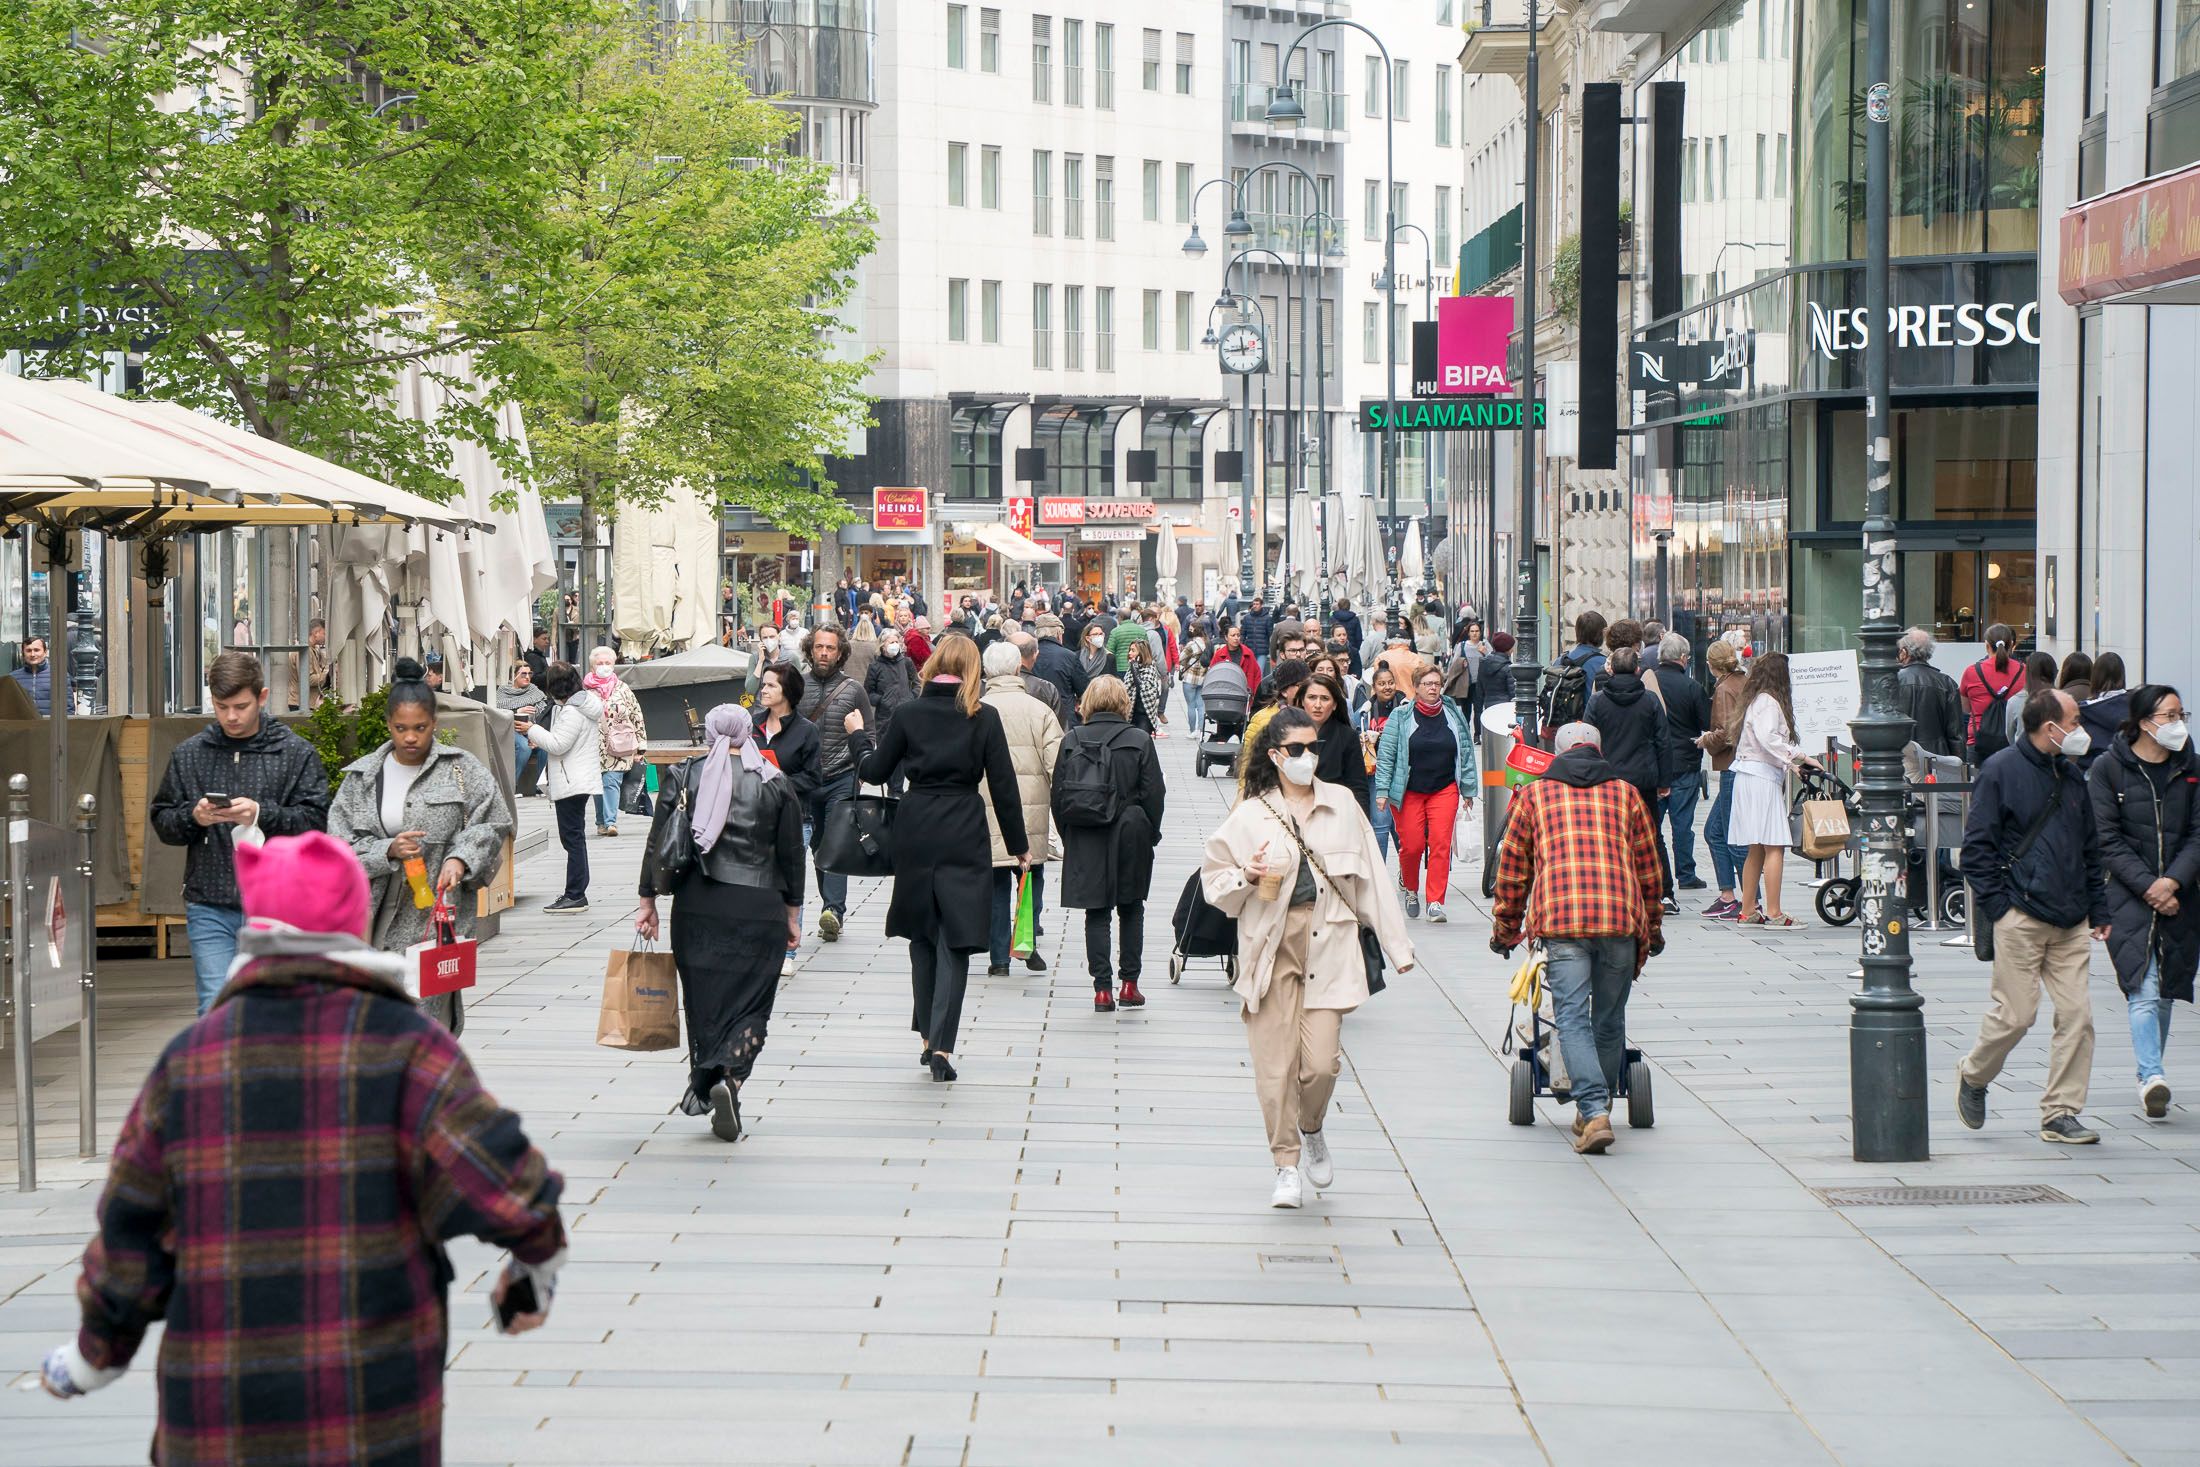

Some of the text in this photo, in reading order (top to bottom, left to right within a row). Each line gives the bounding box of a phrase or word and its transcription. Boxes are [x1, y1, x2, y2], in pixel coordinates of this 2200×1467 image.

[1445, 365, 1505, 386] BIPA
[1369, 403, 1545, 428] SALAMANDER
[879, 503, 922, 513] HEINDL
[1045, 502, 1083, 519] SOUVENIRS
[1088, 502, 1155, 519] SOUVENIRS
[1092, 530, 1136, 539] SOUVENIRS
[1808, 664, 1842, 673] Gesundheit
[437, 958, 460, 977] STEFFL
